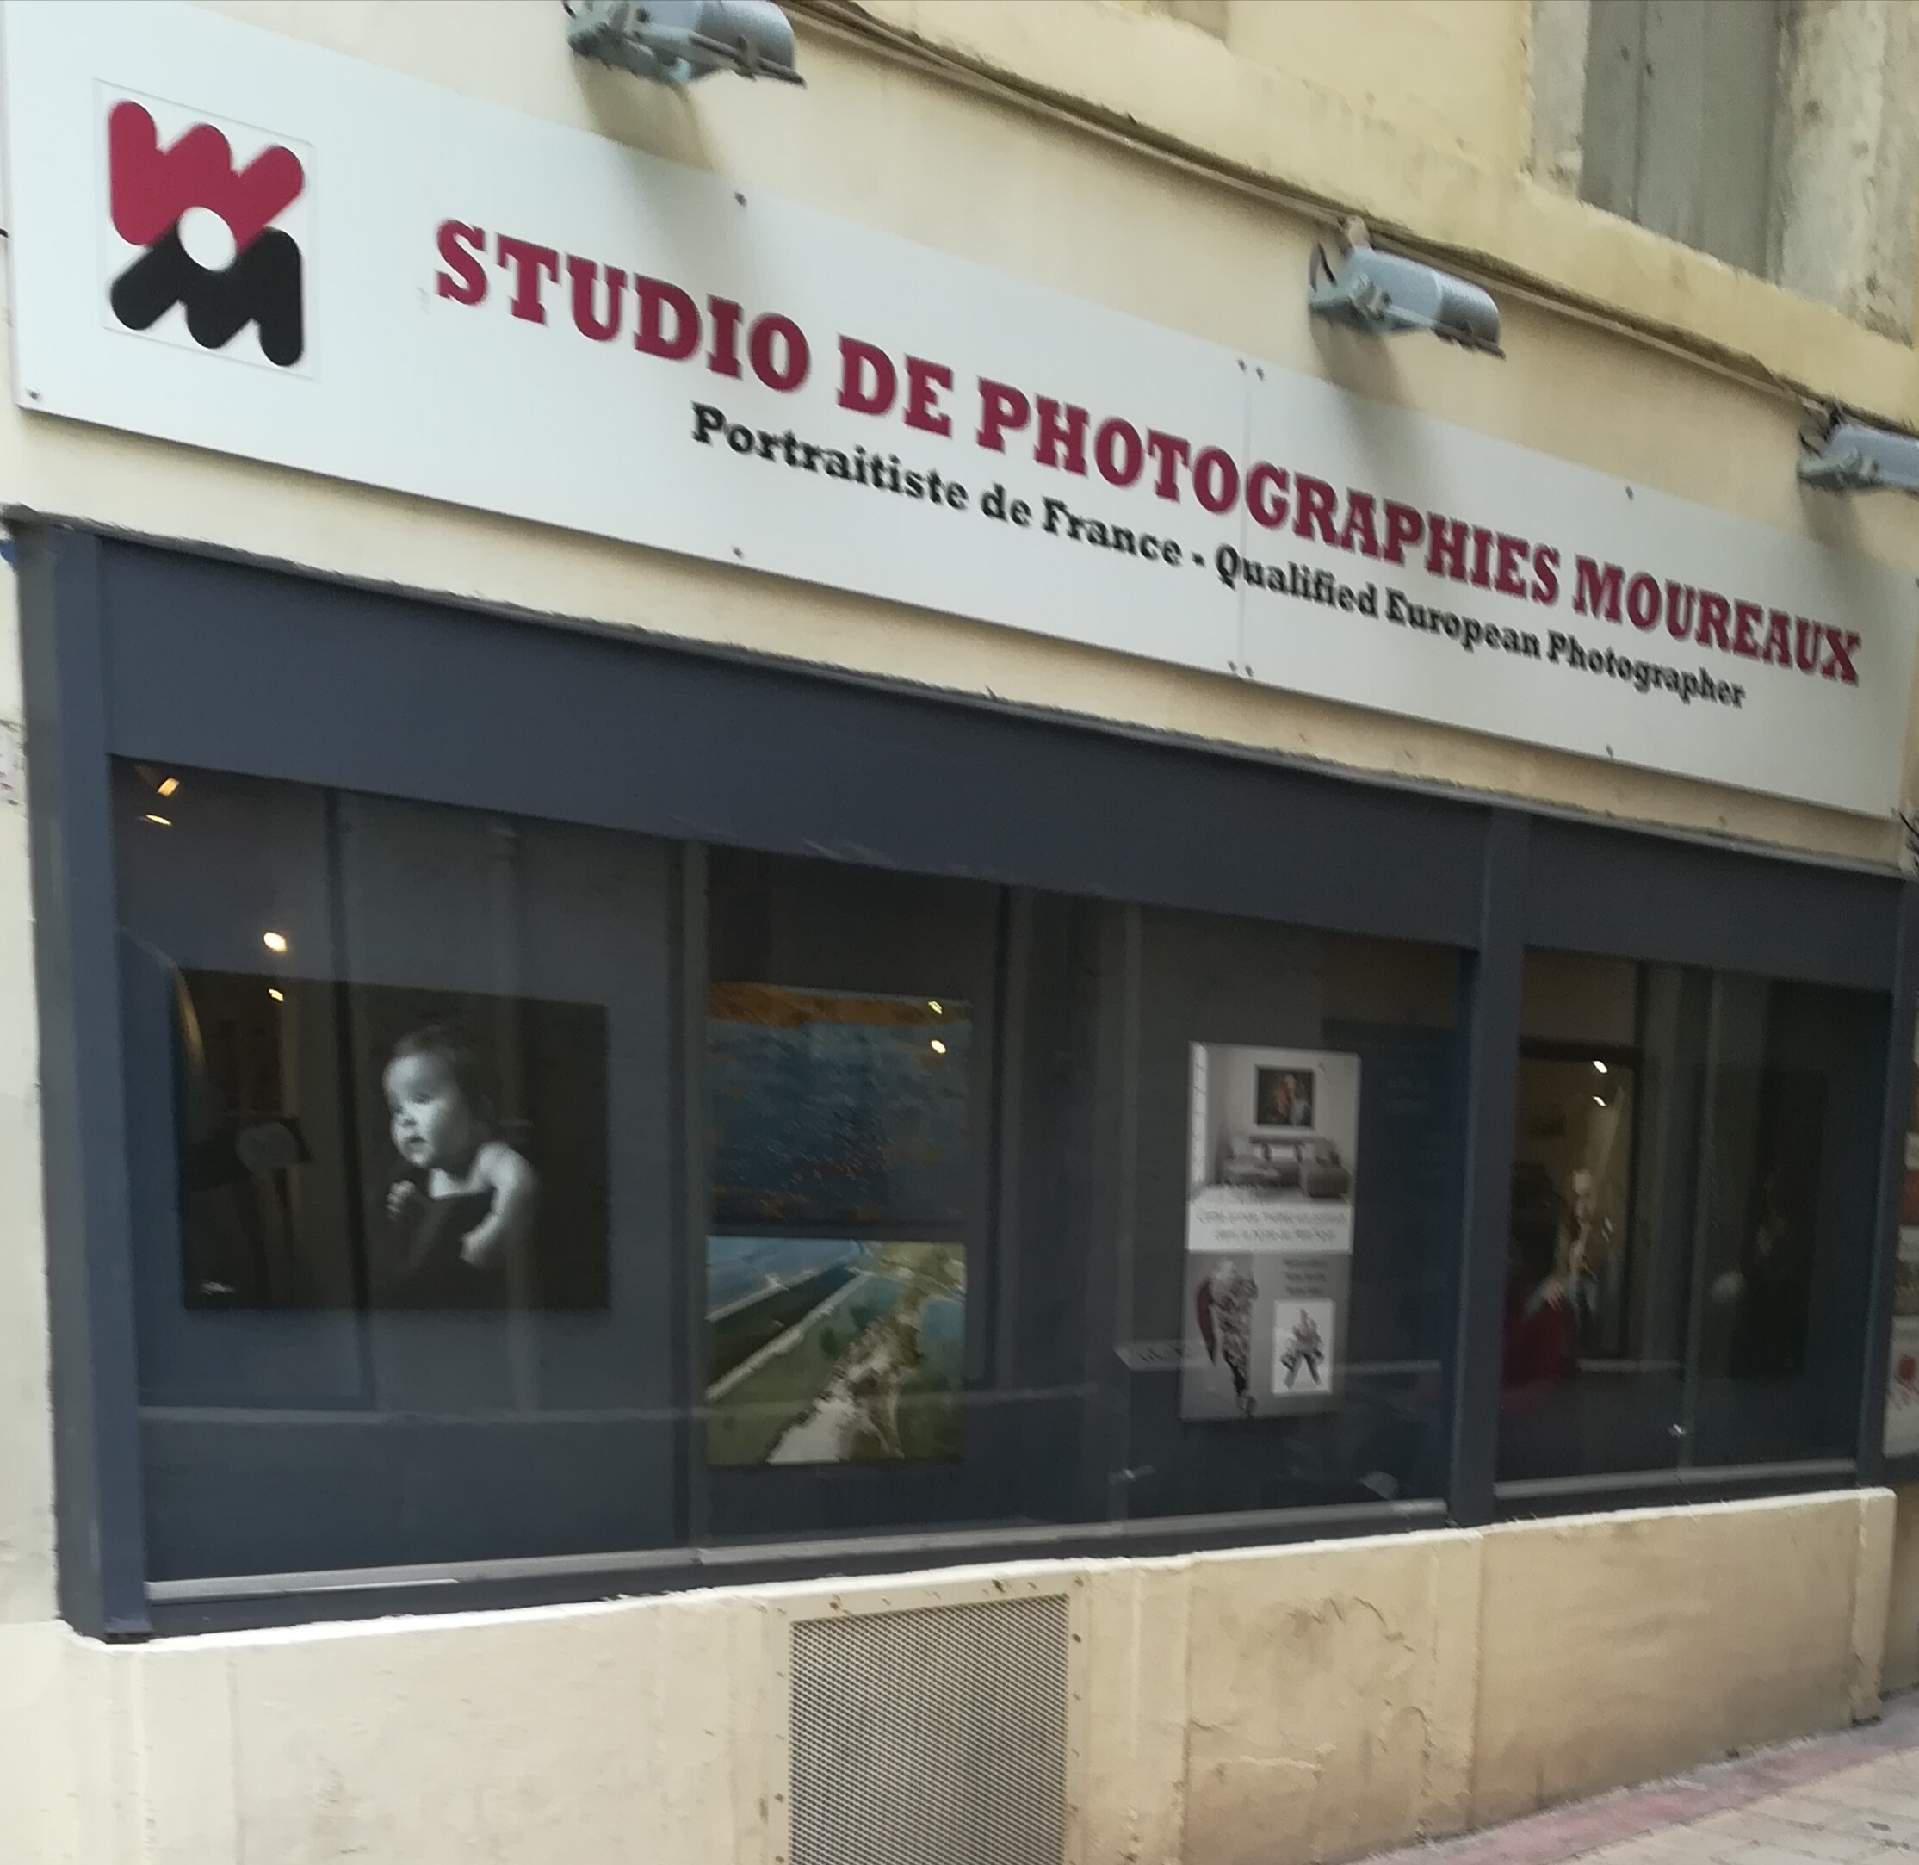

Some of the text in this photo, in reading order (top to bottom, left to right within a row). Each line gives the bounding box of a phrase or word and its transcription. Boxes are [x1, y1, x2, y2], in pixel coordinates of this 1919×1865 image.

[435, 219, 1862, 687] STUDIO DE PHOTOGRAPHIES MOUREAUX
[691, 400, 969, 511] Portraitiste
[980, 483, 1032, 527] de
[1042, 496, 1183, 568] France
[1215, 543, 1378, 619] Qualified
[1383, 587, 1541, 652] European
[1546, 628, 1747, 708] Photographer
